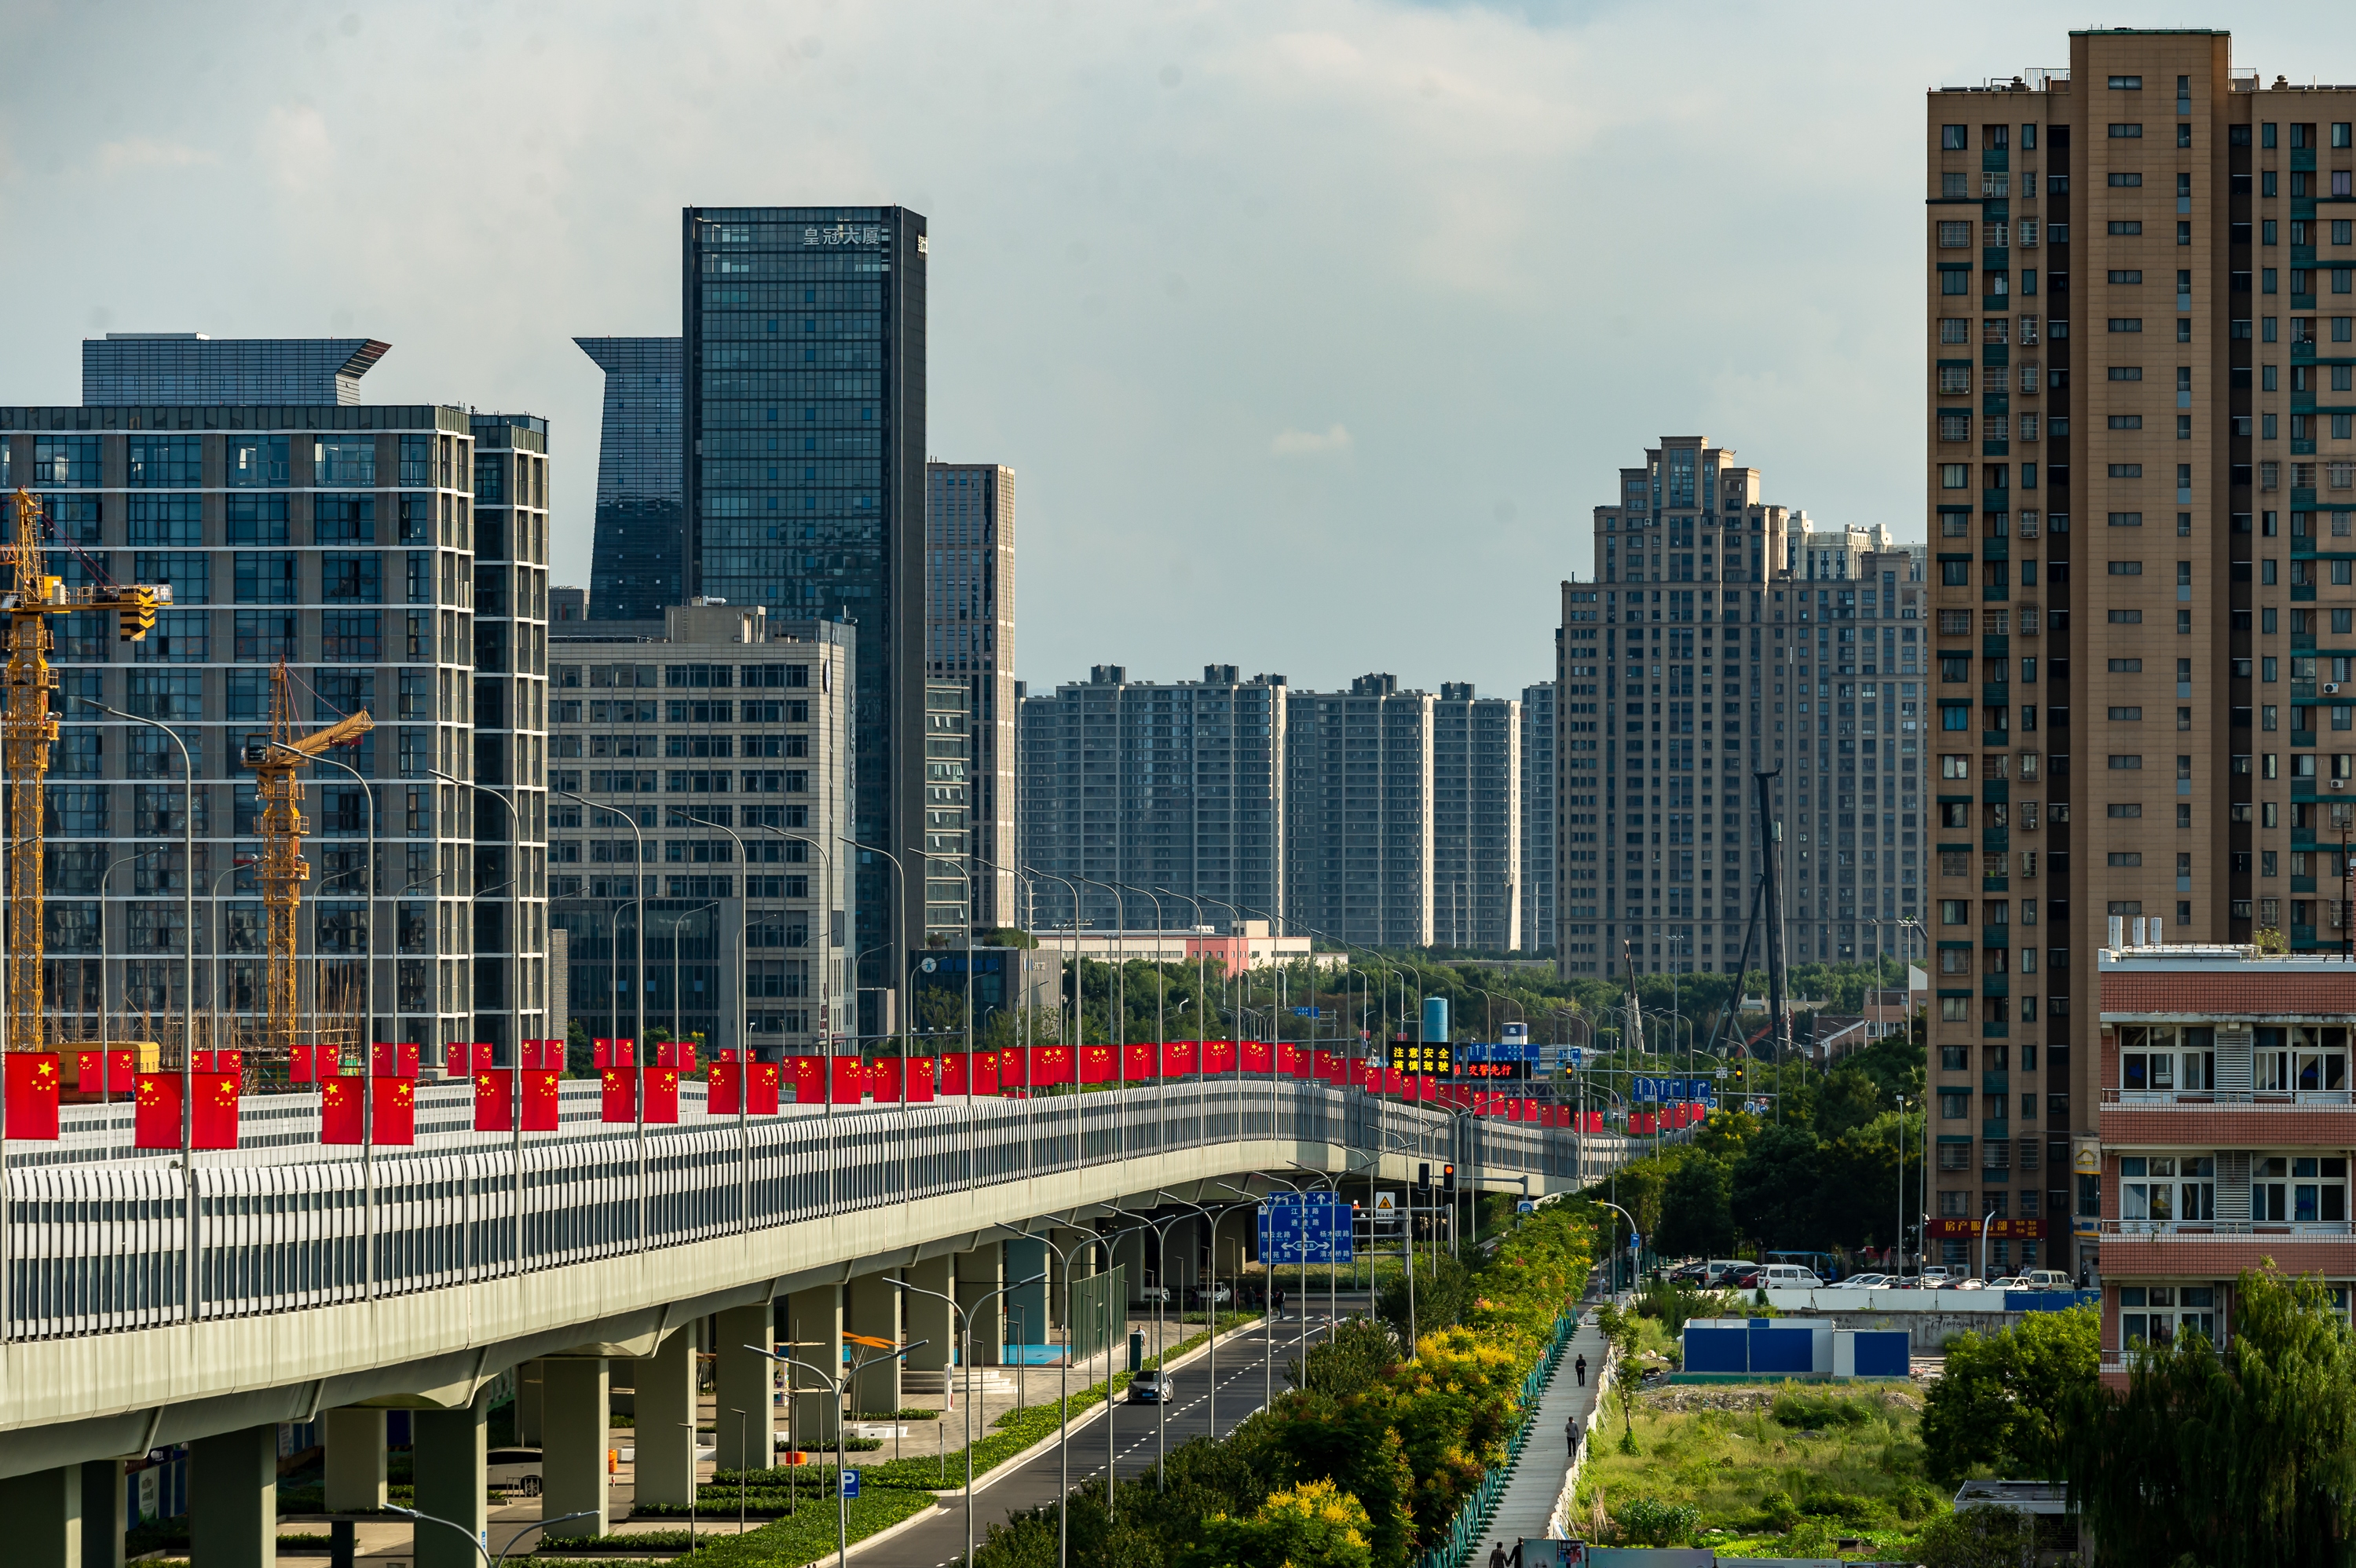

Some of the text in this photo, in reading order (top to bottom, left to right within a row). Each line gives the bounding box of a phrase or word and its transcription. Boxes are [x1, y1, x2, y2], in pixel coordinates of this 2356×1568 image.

[803, 228, 880, 245] 皇冠大厦
[1393, 1047, 1449, 1059] 注意安全
[1392, 1060, 1449, 1072] 谨慎驾驶
[1469, 1064, 1513, 1076] 交警先行
[842, 1472, 855, 1489] P
